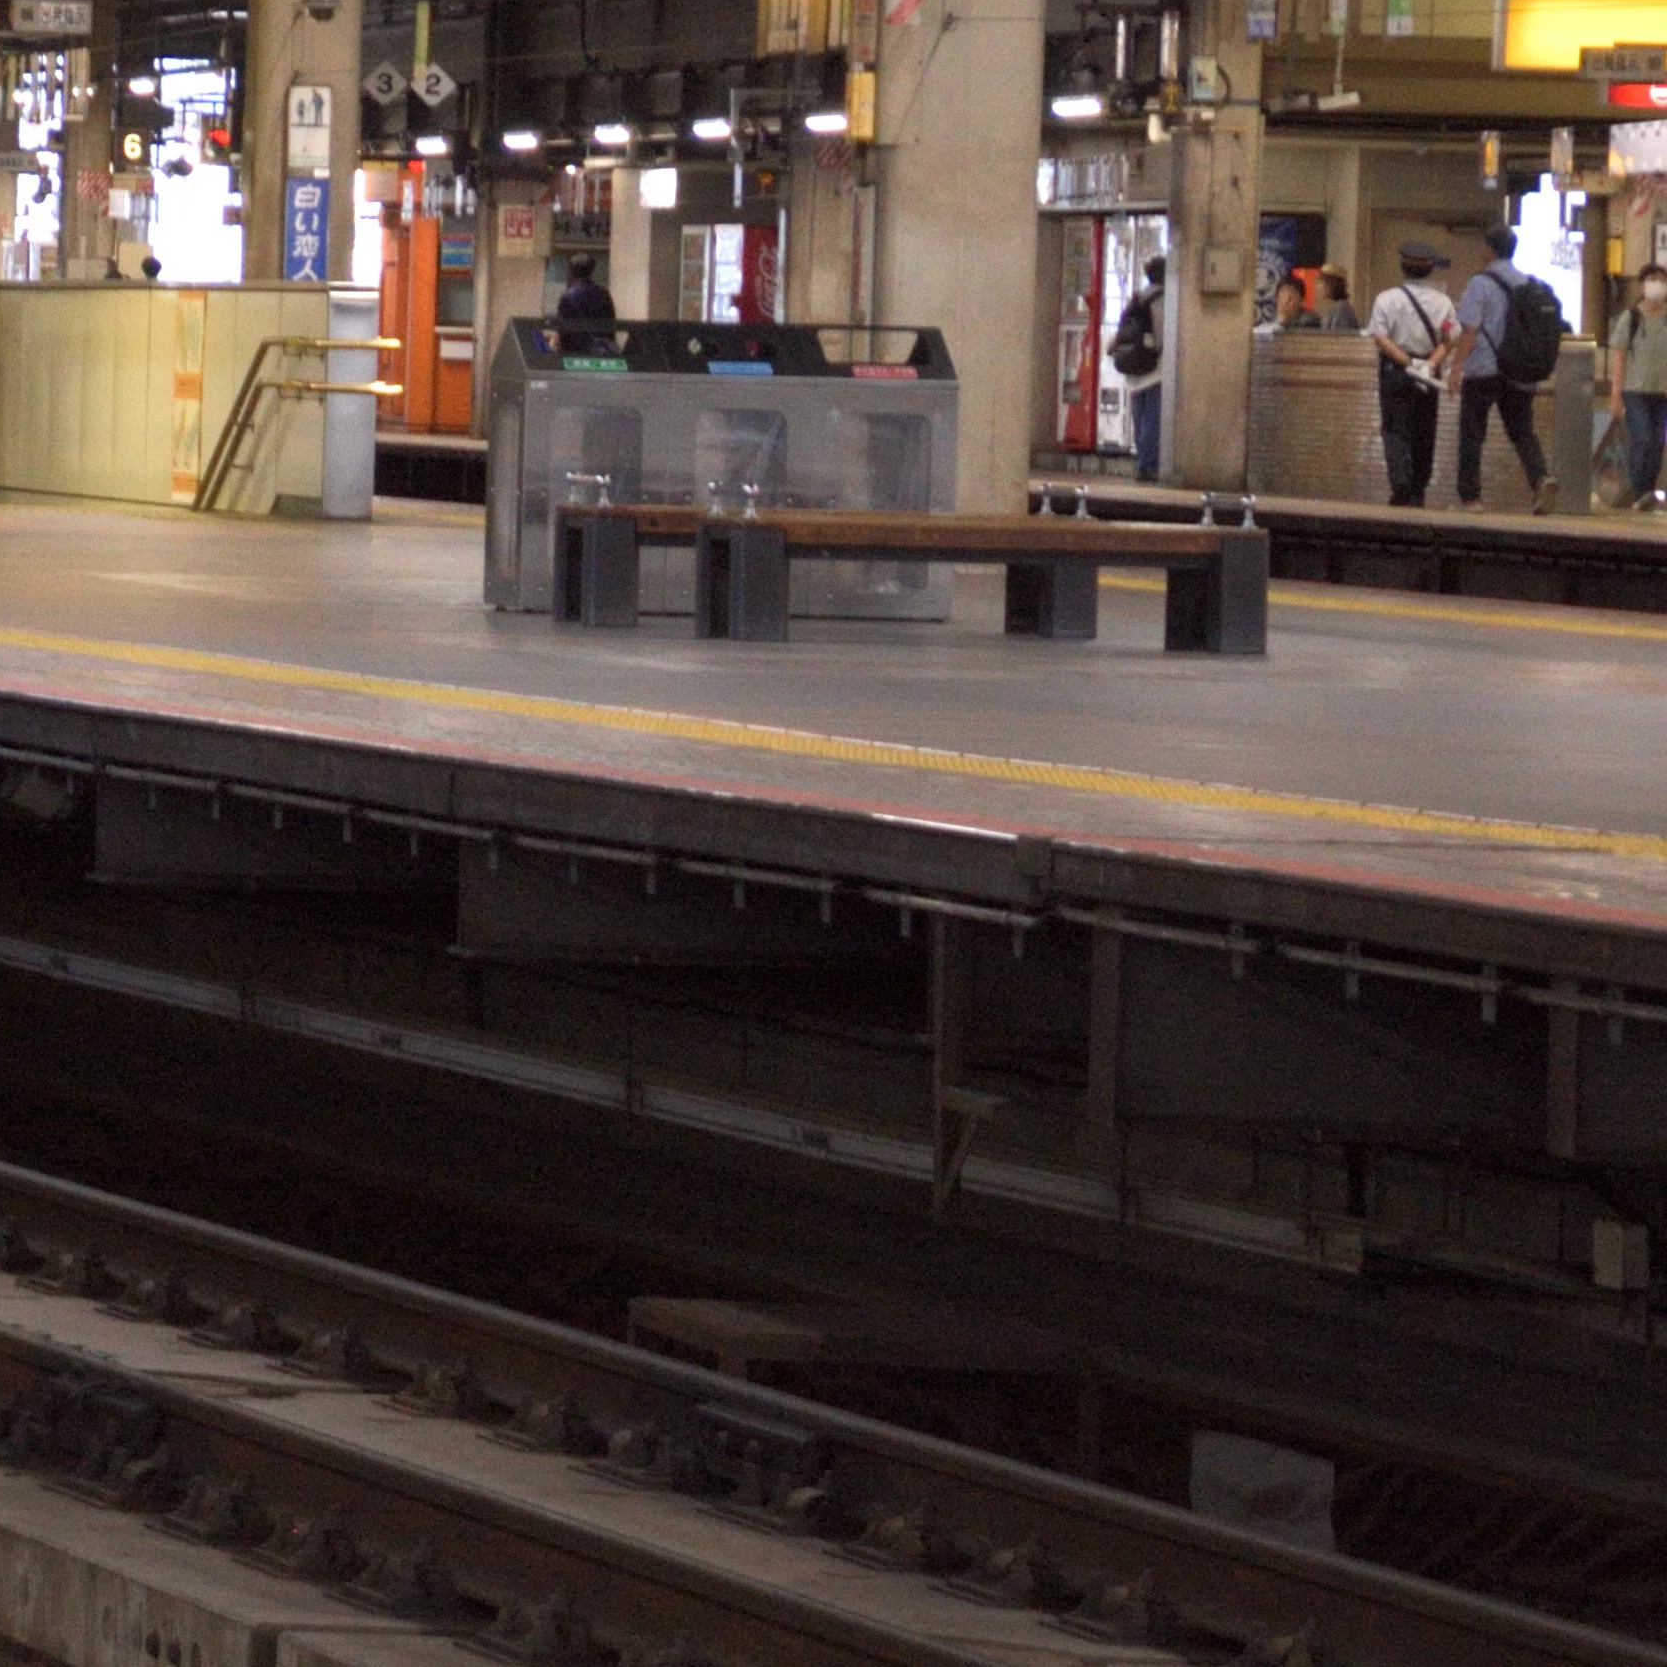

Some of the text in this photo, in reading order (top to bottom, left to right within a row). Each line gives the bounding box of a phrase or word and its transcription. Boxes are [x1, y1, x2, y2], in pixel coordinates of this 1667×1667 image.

[377, 72, 392, 95] 3
[425, 73, 441, 96] 2
[123, 133, 142, 160] 6
[293, 183, 322, 281] 白い恋人
